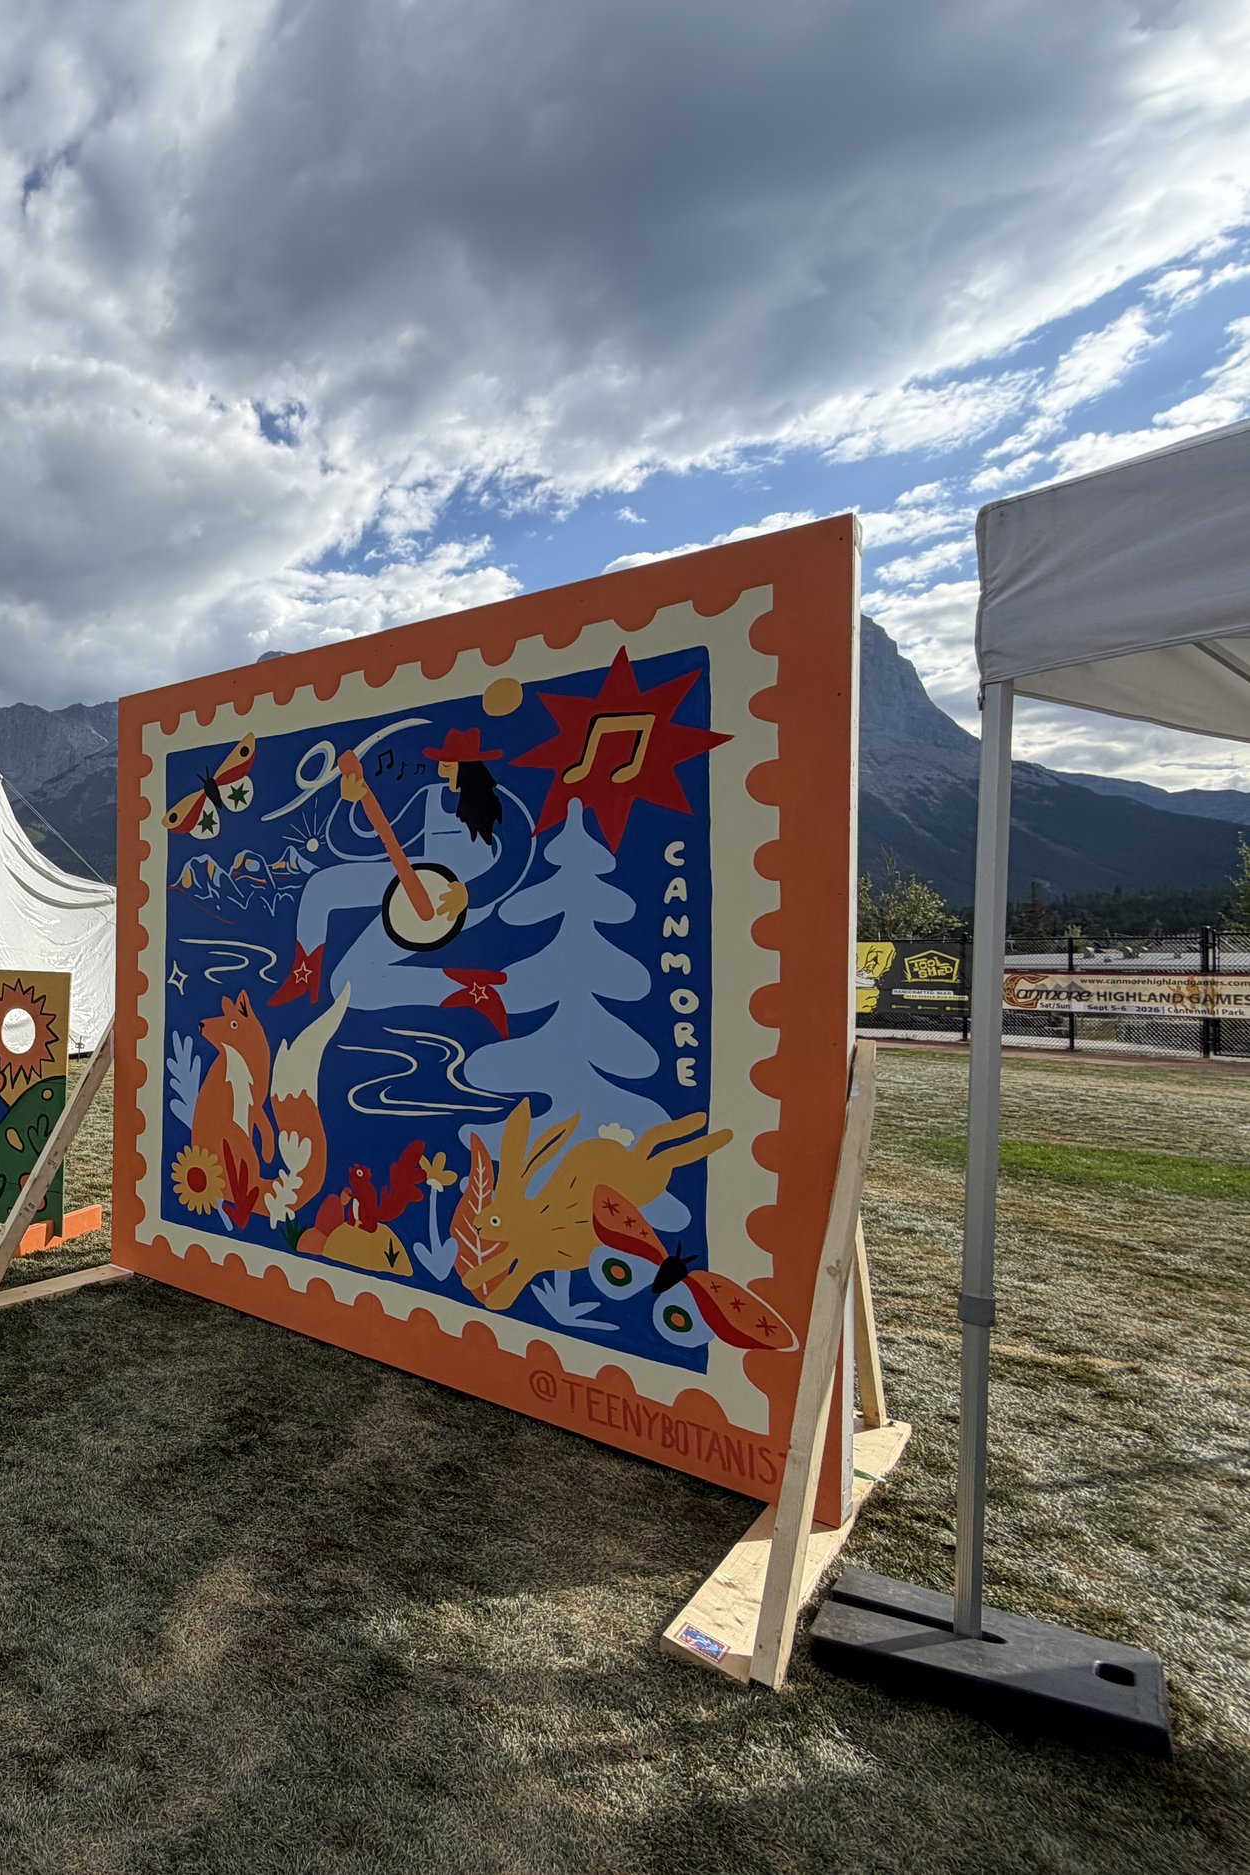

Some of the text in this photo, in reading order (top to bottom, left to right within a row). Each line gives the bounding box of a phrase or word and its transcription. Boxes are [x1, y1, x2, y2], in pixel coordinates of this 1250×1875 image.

[662, 840, 700, 1087] CANMORE
[909, 957, 950, 970] TOOL
[918, 966, 953, 978] SHED
[1097, 991, 1185, 1005] HIGHLAND
[1188, 992, 1250, 1006] GAMES
[1167, 1006, 1220, 1016] Centennial
[1221, 1008, 1245, 1016] Park
